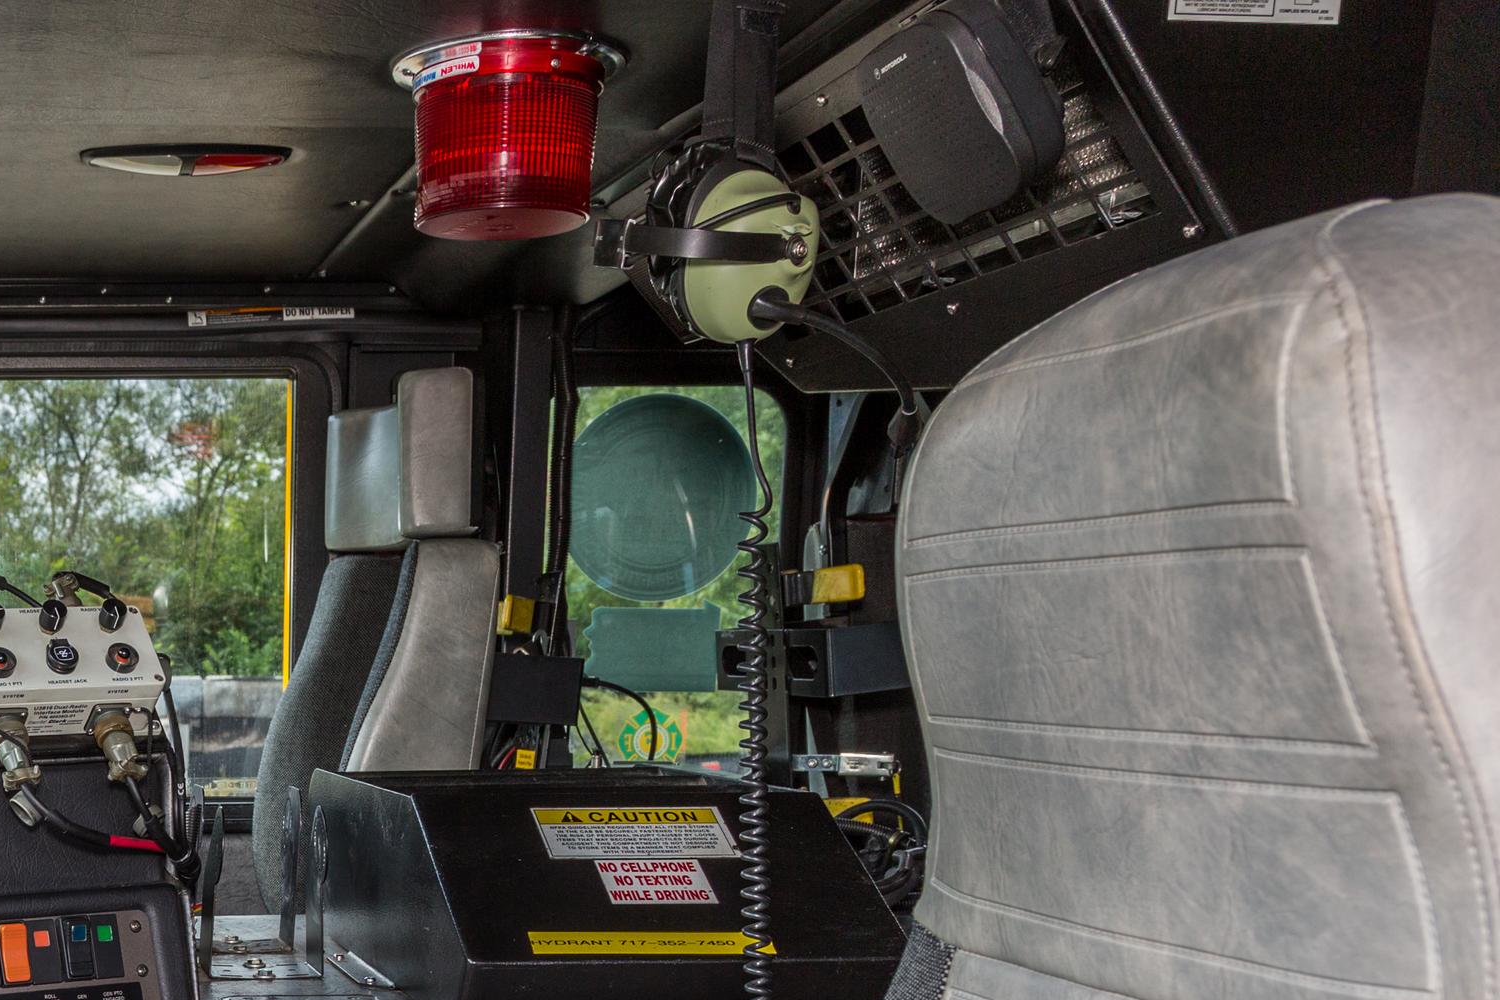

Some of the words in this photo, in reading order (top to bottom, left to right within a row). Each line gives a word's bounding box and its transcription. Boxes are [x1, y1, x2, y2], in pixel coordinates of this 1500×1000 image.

[880, 53, 908, 74] MOTOROLA
[285, 308, 297, 317] DO
[299, 307, 315, 317] NOT
[317, 306, 351, 316] TAMPER
[588, 811, 699, 823] CAUTION
[599, 862, 618, 873] NO
[620, 861, 697, 873] CELLPHONE
[613, 875, 634, 886] NO
[638, 874, 693, 886] TEXTING
[610, 889, 652, 901] WHILE
[655, 889, 710, 901] DRIVING
[530, 938, 612, 947] HYDRANT
[620, 938, 736, 947] 717-352-7450
